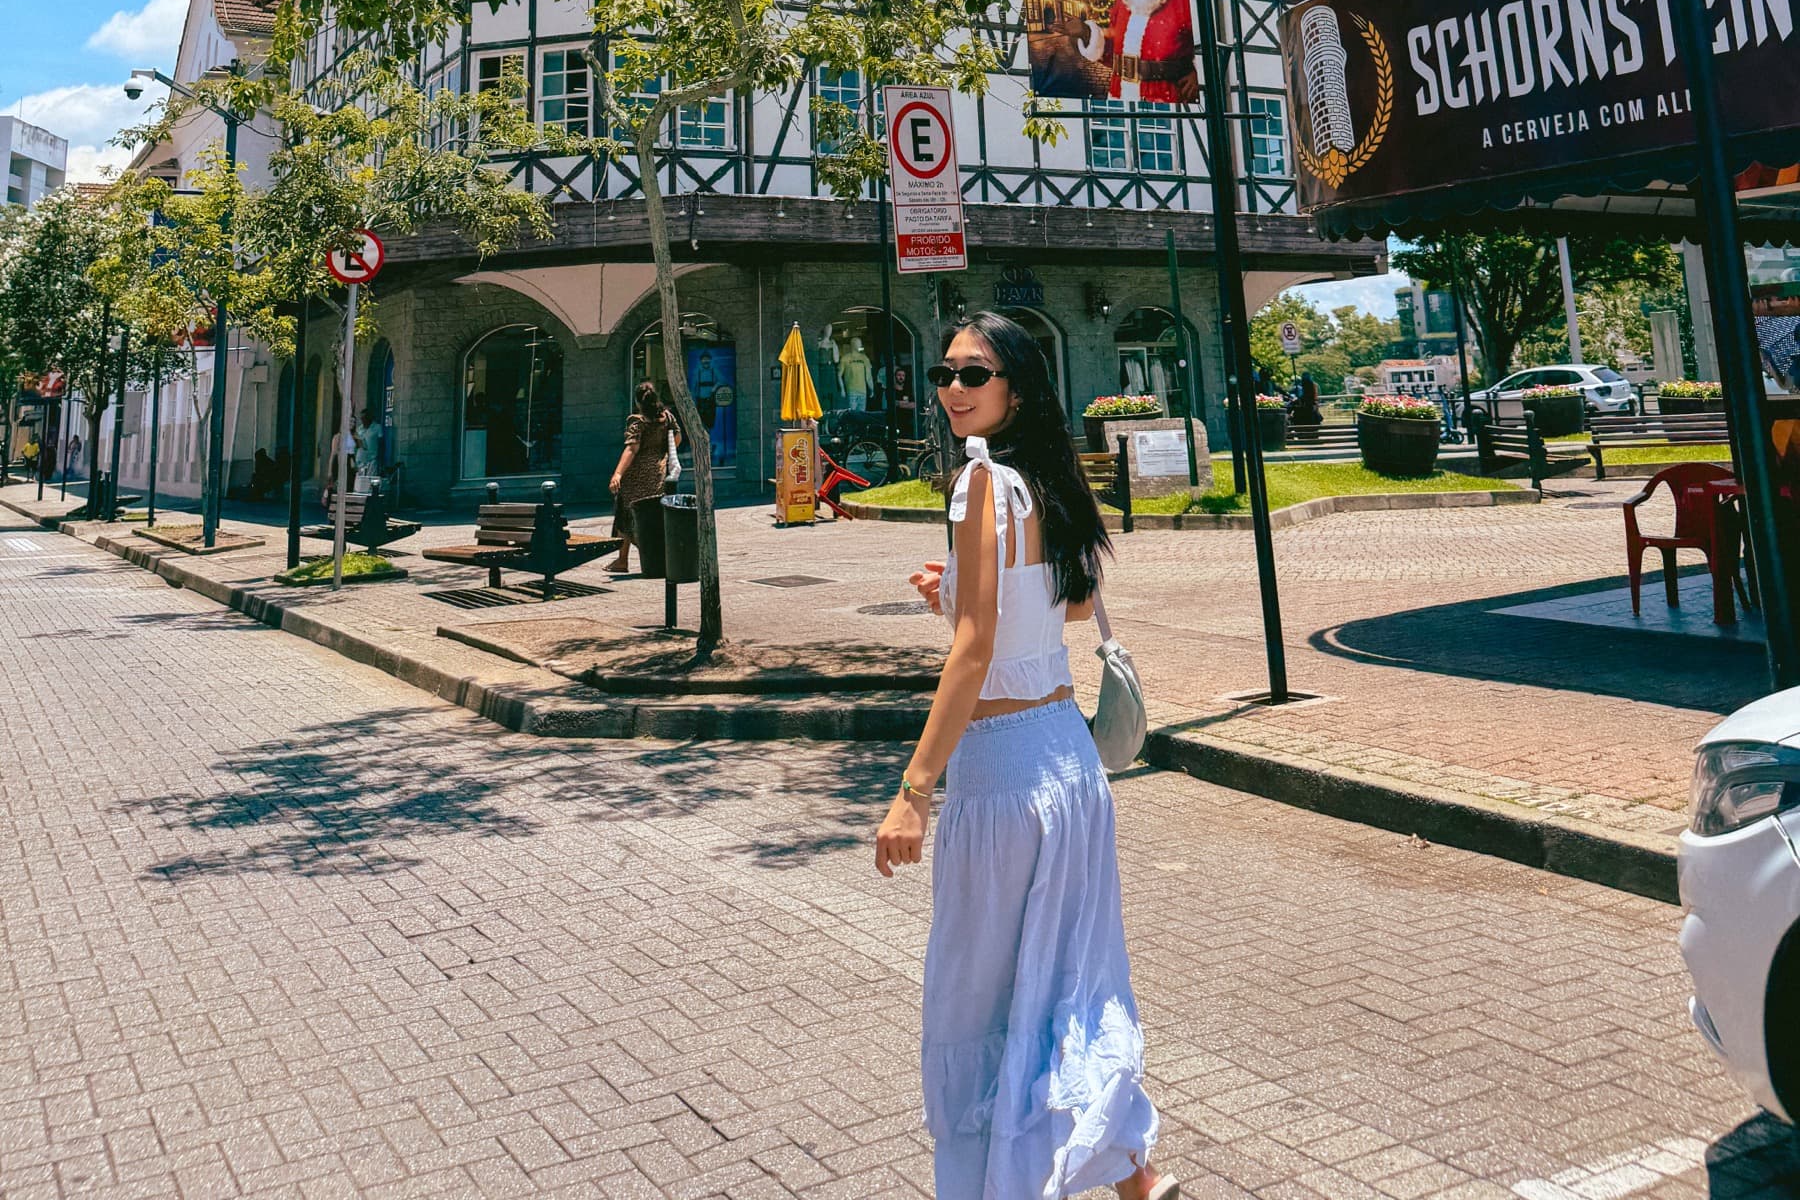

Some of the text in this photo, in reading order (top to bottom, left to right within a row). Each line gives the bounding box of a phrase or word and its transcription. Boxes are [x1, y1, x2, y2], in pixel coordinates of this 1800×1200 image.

[919, 92, 935, 100] AZUL
[1482, 127, 1493, 149] A
[1501, 109, 1589, 145] CERVEJA
[1599, 98, 1645, 127] COM
[910, 118, 934, 161] E
[911, 235, 951, 245] PROIBIDO
[906, 247, 937, 256] MOTOS
[943, 246, 957, 255] 24h
